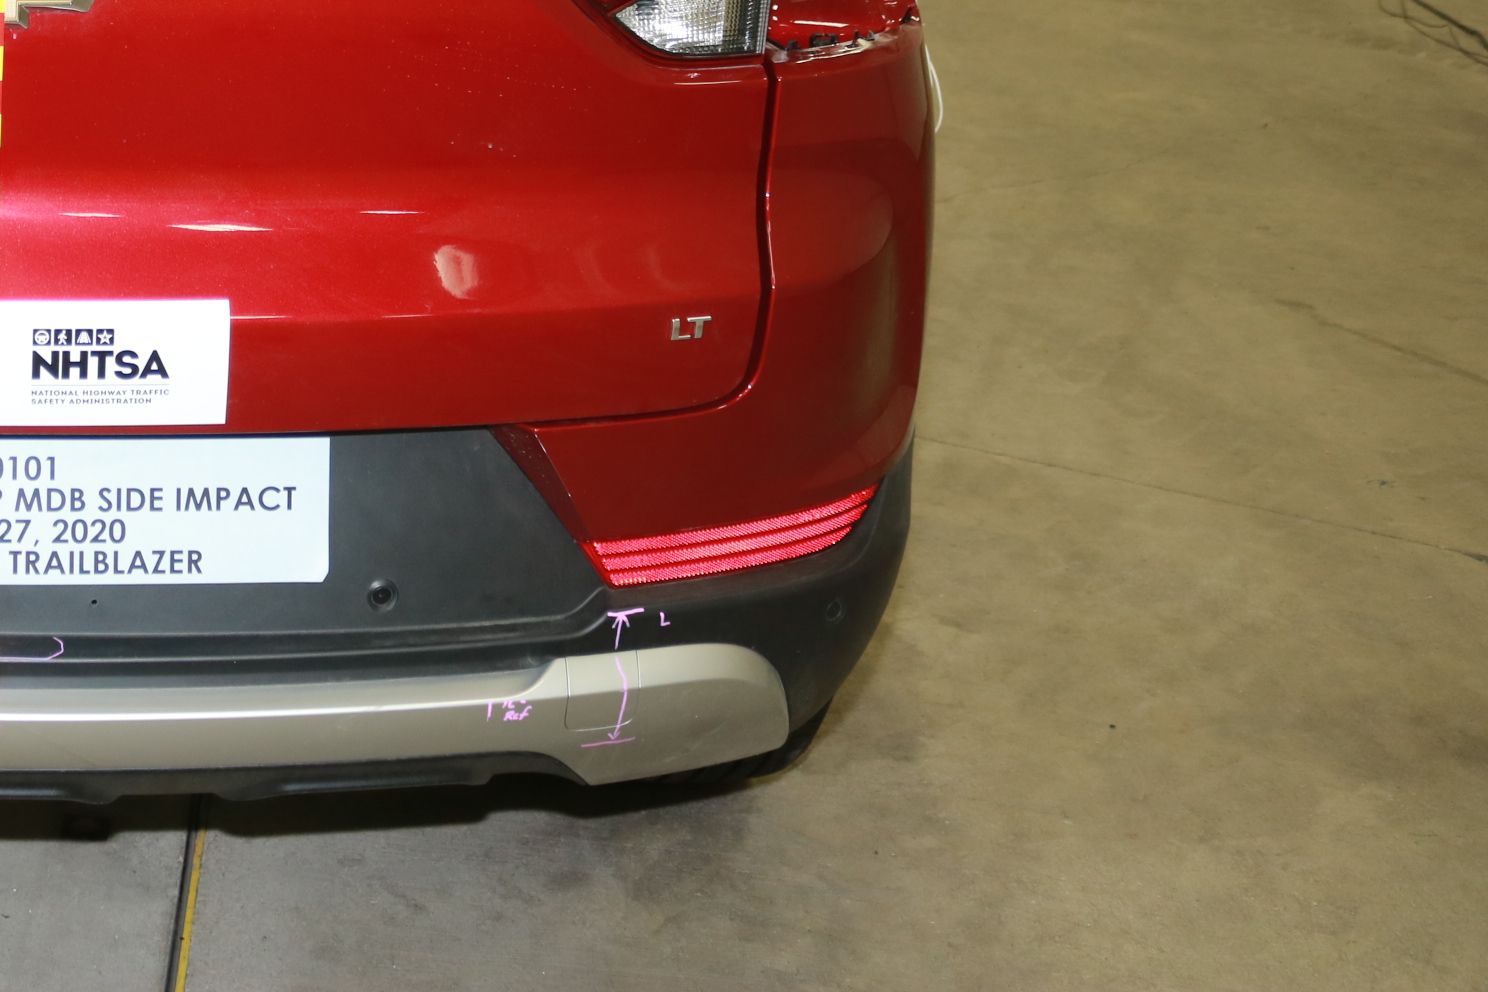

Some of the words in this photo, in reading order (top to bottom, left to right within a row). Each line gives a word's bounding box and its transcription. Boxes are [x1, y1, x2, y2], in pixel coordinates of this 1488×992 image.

[670, 315, 713, 341] LT
[31, 349, 170, 381] NHTSA
[68, 397, 152, 405] ADMINISTRATION
[14, 487, 86, 512] MDB
[98, 487, 164, 512] SIDE
[175, 486, 297, 512] IMPACT
[51, 518, 126, 544] 2020
[8, 549, 203, 576] TRAILBLAZER
